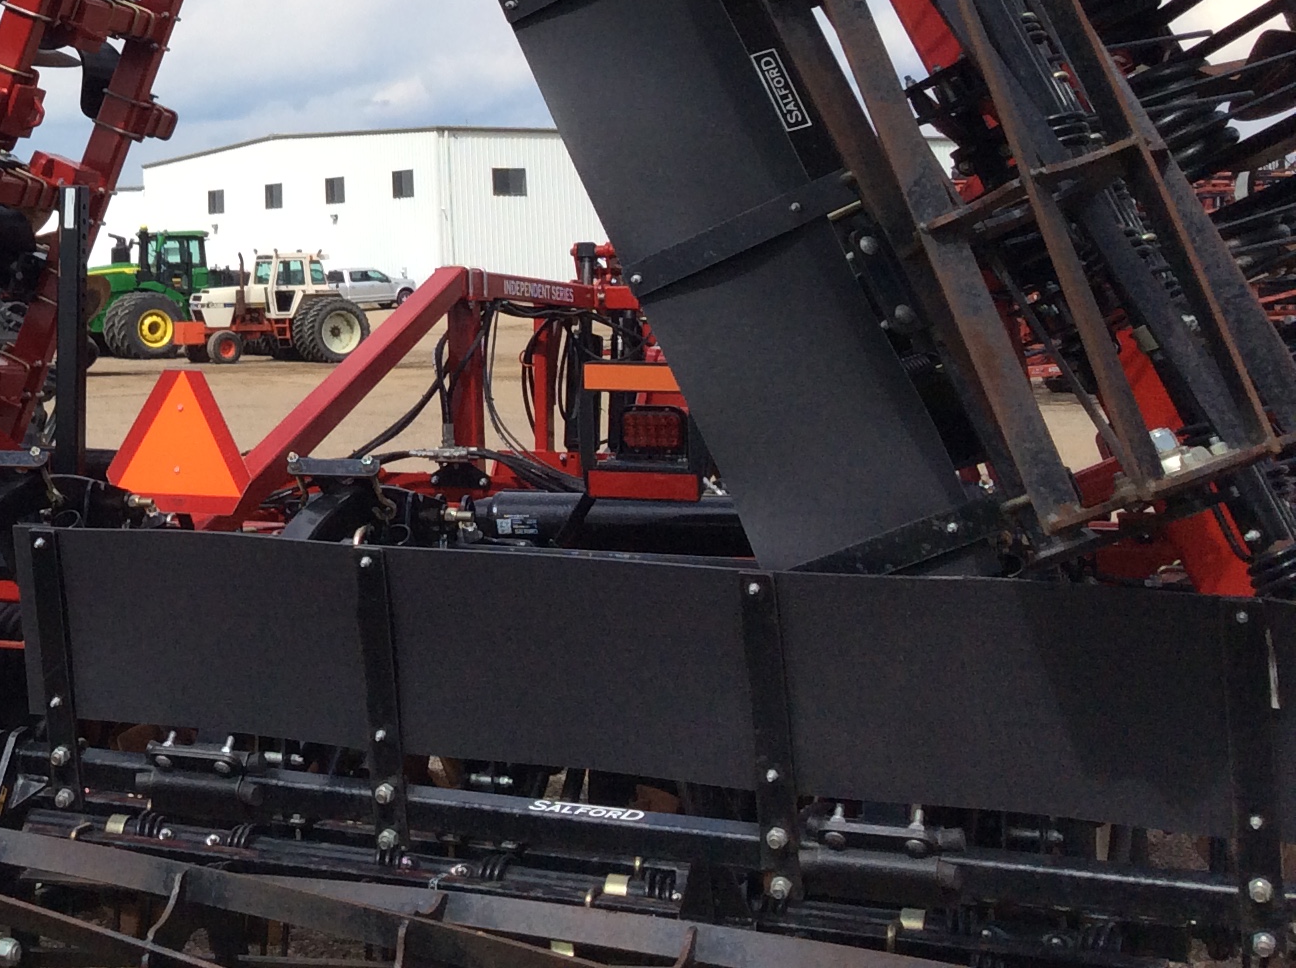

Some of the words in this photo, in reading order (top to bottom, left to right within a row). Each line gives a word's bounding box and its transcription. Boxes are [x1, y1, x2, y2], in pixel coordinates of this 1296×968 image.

[760, 56, 802, 123] SALFORD
[503, 279, 551, 300] INDEPENDENT
[551, 285, 574, 303] SERIES
[528, 799, 645, 821] SALFORD
